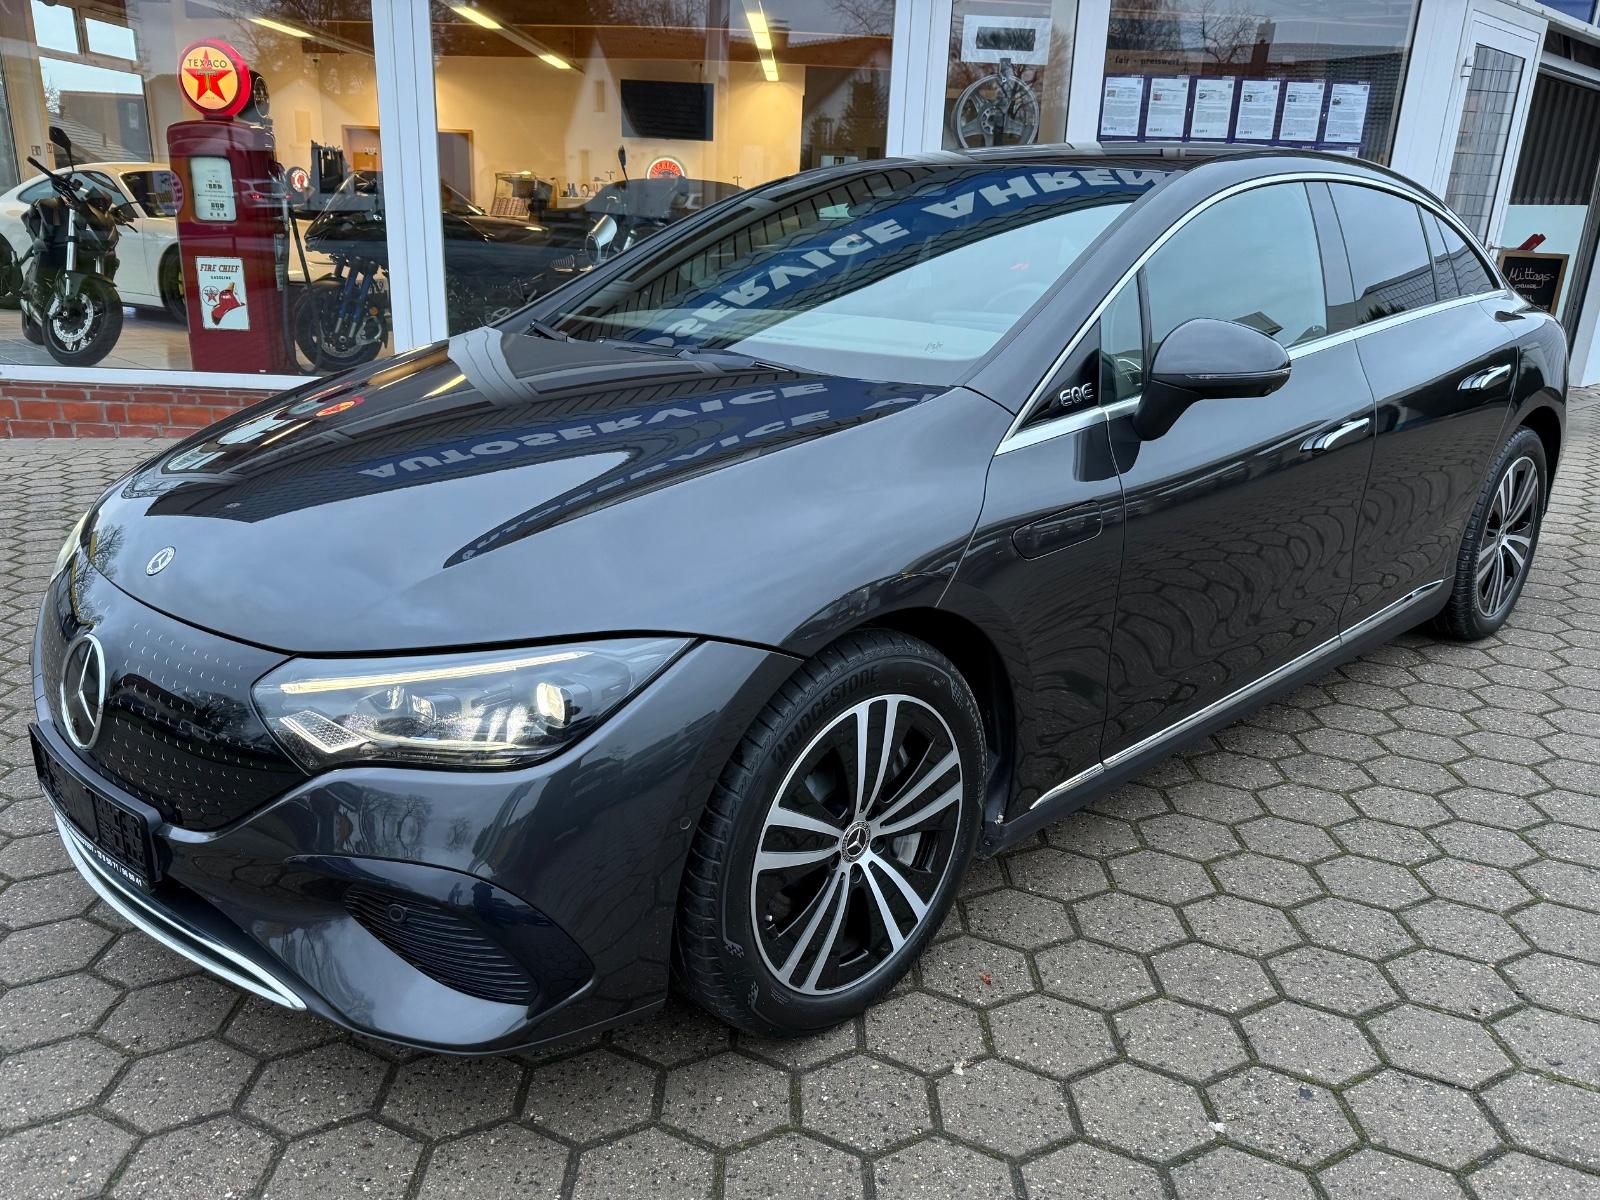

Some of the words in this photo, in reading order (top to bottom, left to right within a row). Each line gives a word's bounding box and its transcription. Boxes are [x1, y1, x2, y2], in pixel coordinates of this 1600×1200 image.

[187, 58, 227, 68] TEXACO
[200, 263, 217, 272] FIRE
[219, 265, 240, 273] CHIEF
[1060, 382, 1094, 406] EQE
[771, 664, 880, 766] BRIDGESTONE
